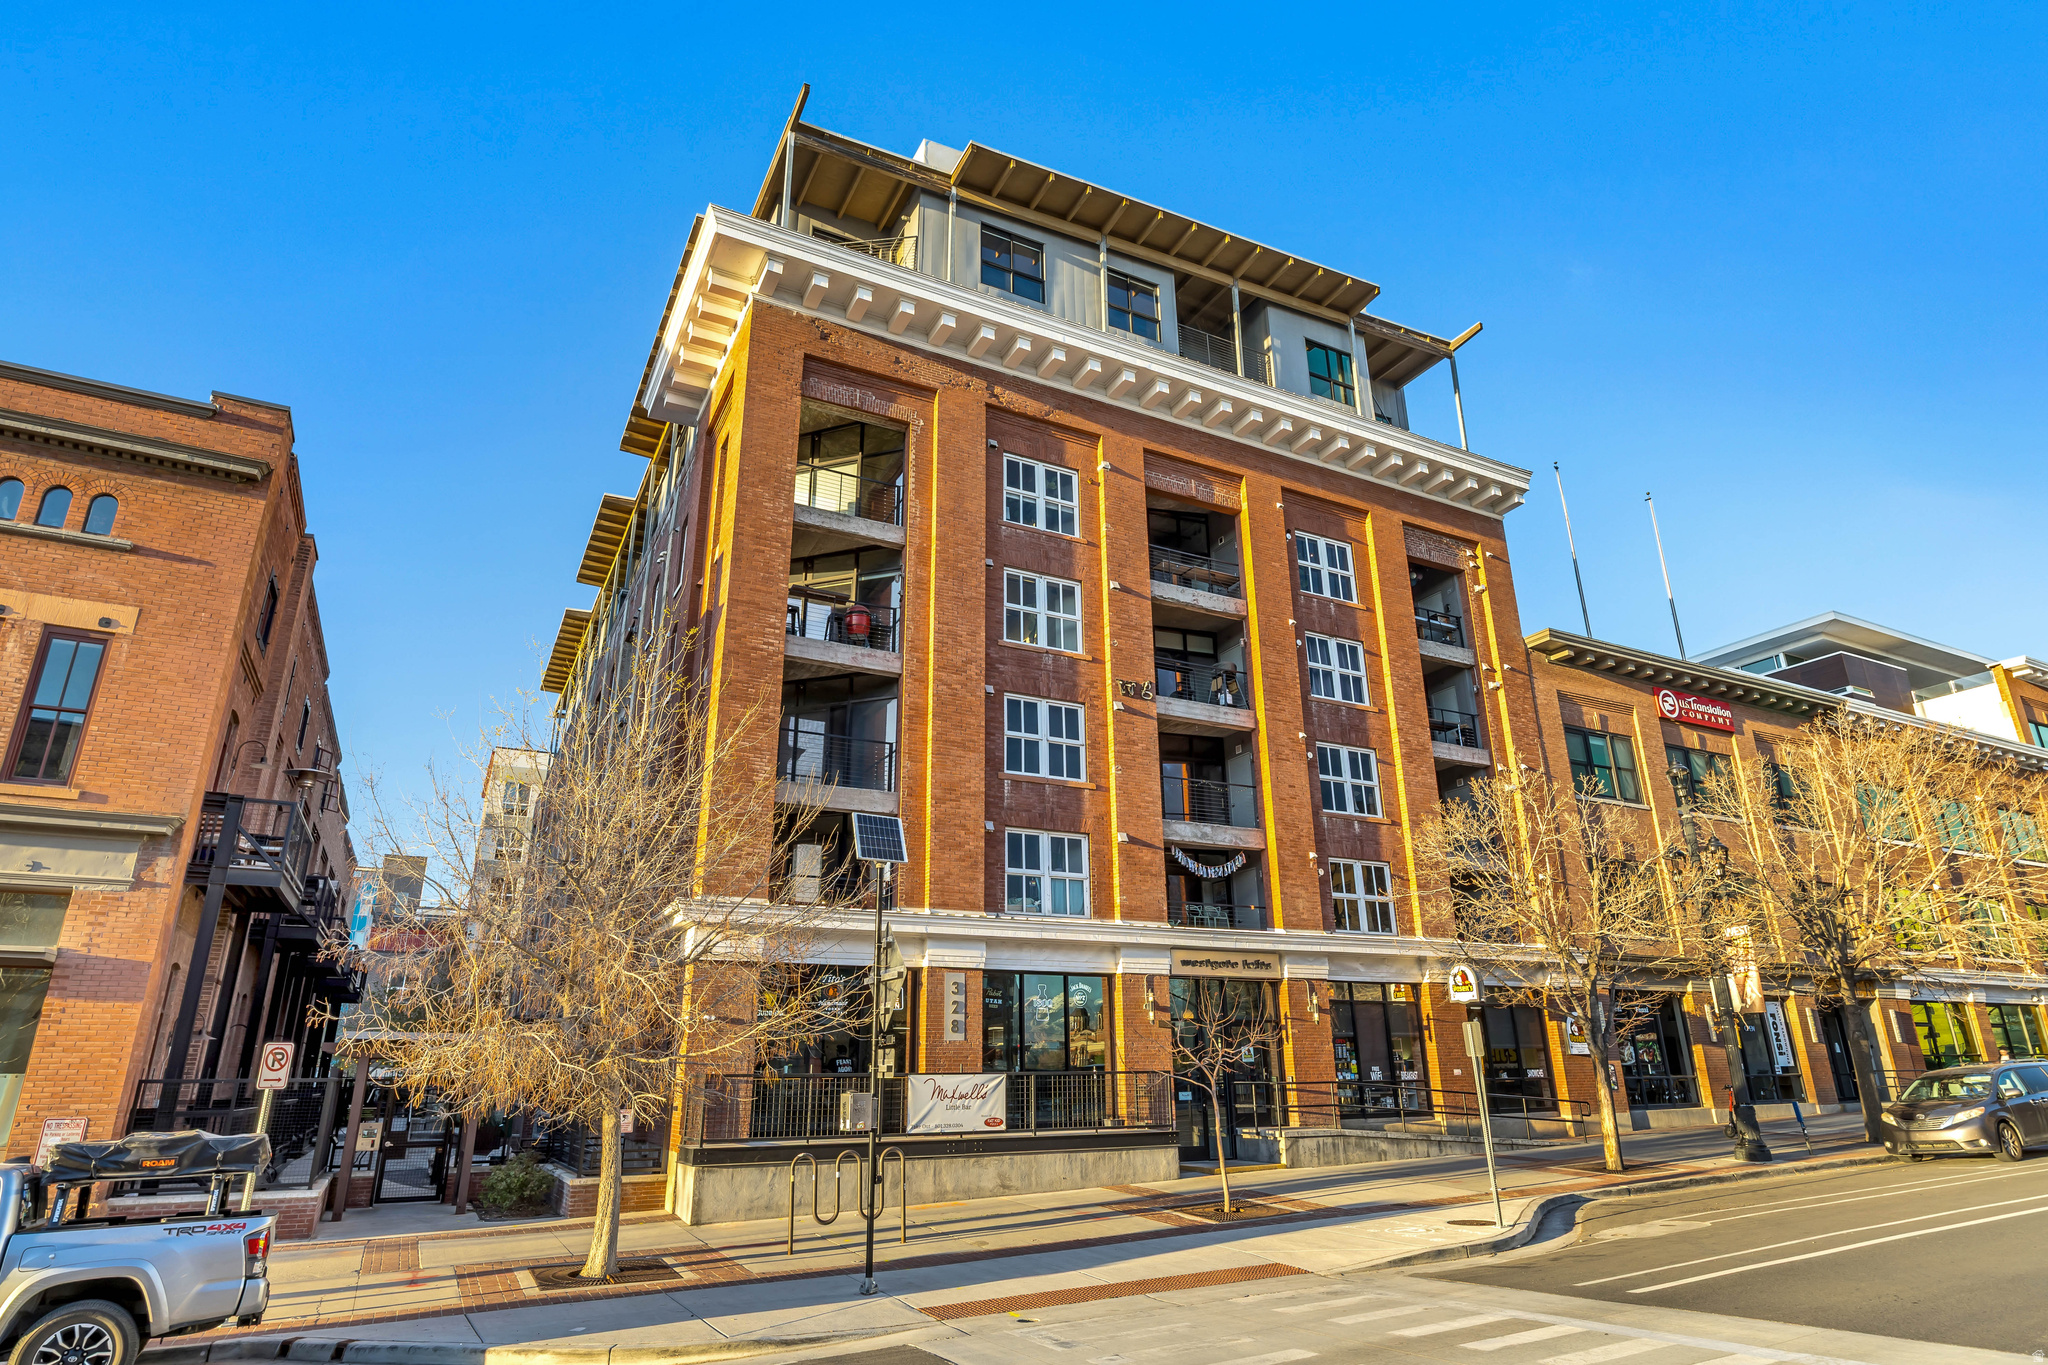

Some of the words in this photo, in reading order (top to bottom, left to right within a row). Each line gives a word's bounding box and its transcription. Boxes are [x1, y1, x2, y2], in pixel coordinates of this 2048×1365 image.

[1685, 697, 1732, 718] Translation
[1681, 709, 1730, 726] COMPANY
[822, 975, 846, 983] Tito's
[46, 1122, 53, 1130] NO
[54, 1121, 83, 1130] TRESPASSING
[142, 1159, 175, 1168] ROAM
[163, 1225, 207, 1237] TRD
